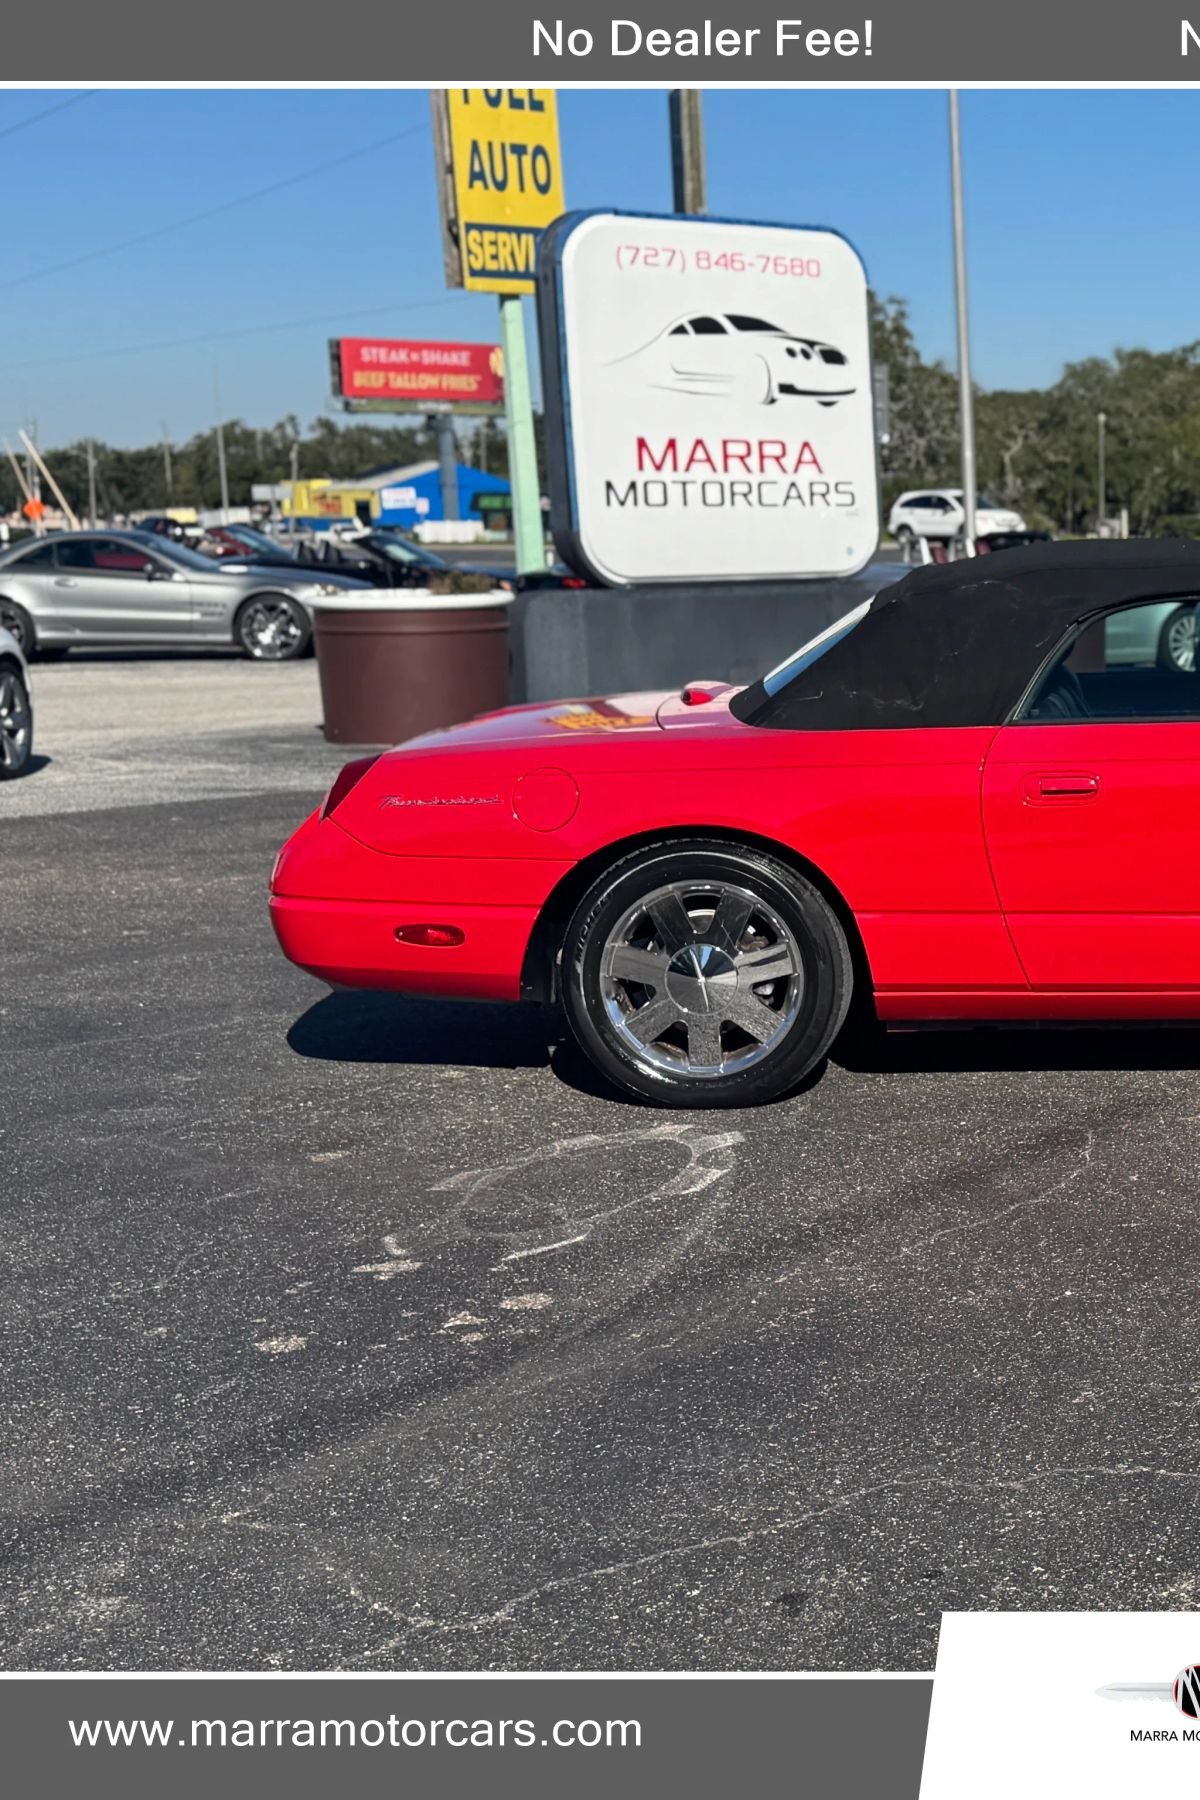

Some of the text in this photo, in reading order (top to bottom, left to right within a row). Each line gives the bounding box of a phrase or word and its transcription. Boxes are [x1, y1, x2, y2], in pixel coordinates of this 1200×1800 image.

[468, 139, 552, 195] AUTO
[467, 228, 536, 272] SERVI
[615, 245, 822, 279] (727) 846-7680
[360, 346, 409, 364] STEAK
[421, 350, 471, 367] SHAKE
[636, 437, 823, 474] MARRA
[605, 479, 856, 508] MOTORCARS
